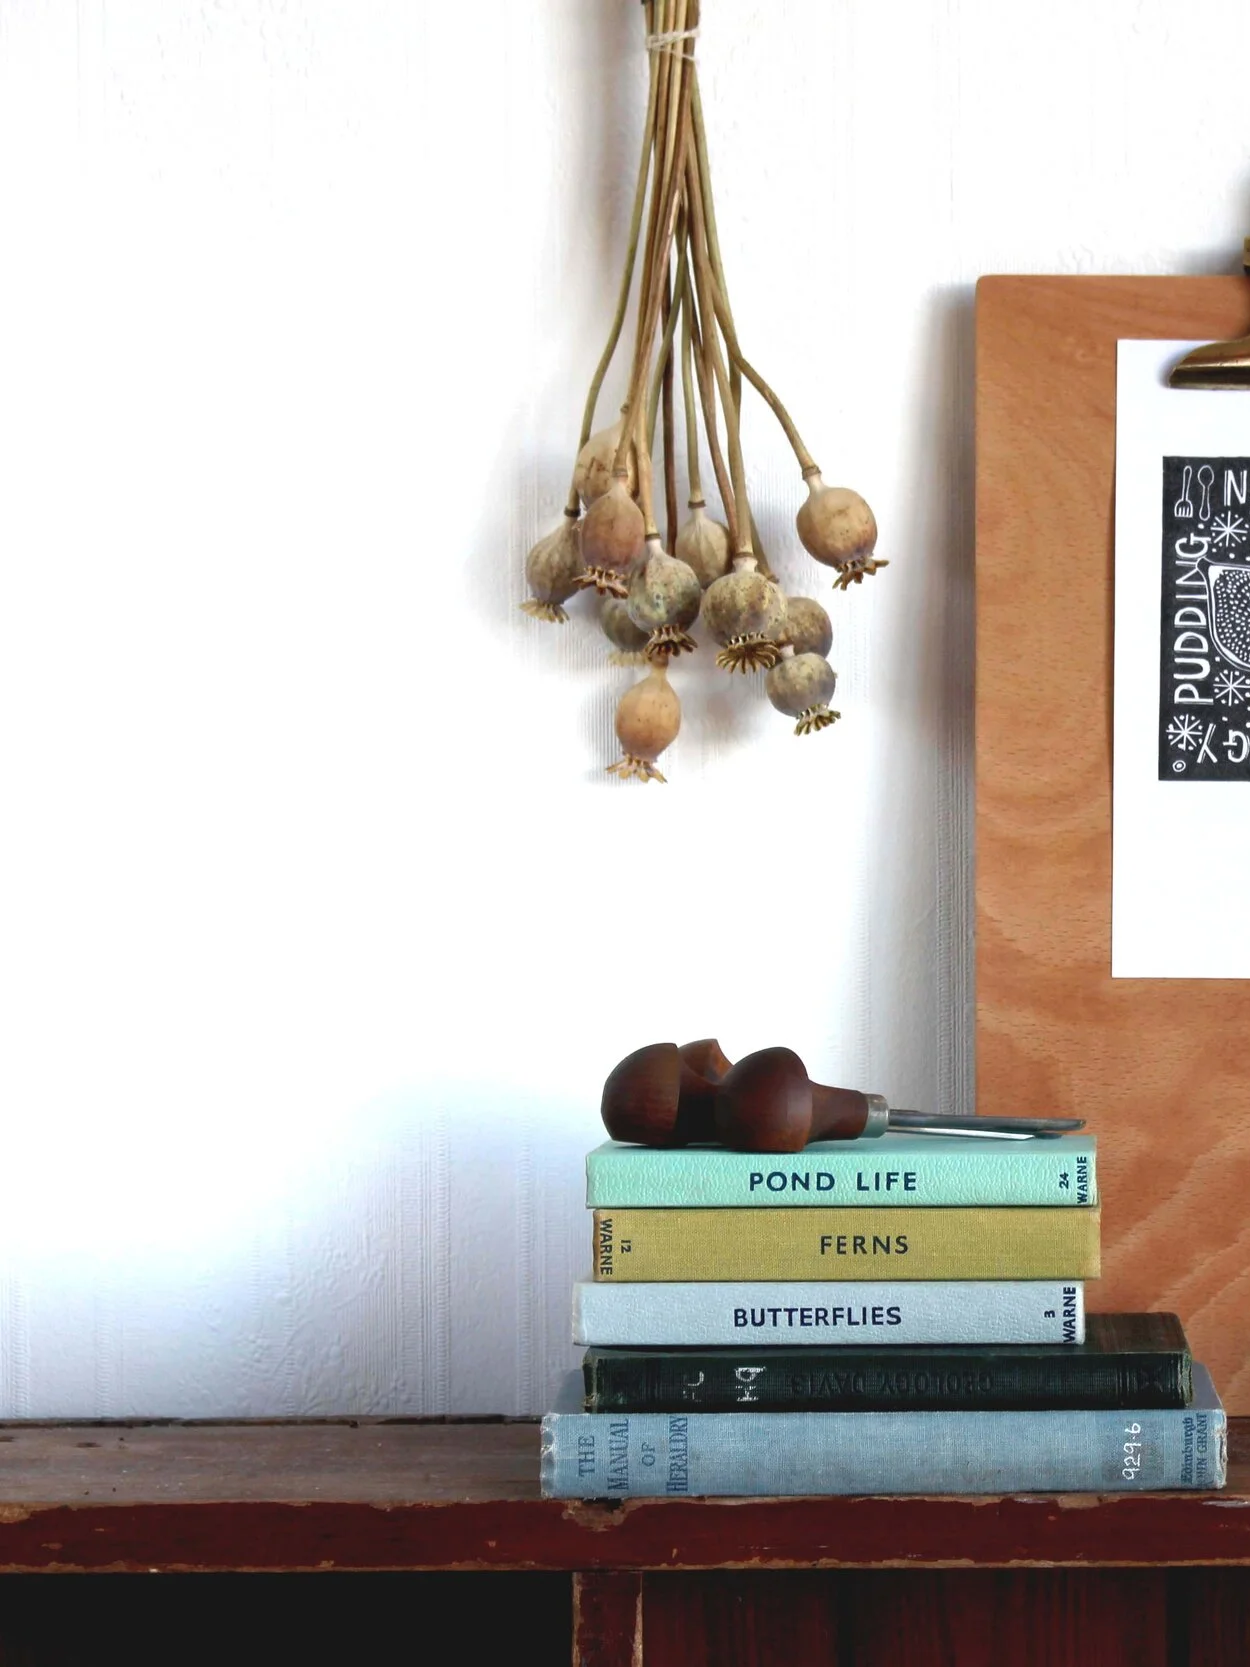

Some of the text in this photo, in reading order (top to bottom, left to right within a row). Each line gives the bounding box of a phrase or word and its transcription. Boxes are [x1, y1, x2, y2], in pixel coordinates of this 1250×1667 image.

[1173, 532, 1214, 704] PUDDING
[750, 1172, 917, 1191] POND LIFE
[1059, 1172, 1070, 1189] 24
[1077, 1156, 1088, 1204] WARNE
[600, 1219, 613, 1276] WARNE
[820, 1235, 909, 1255] FERNS
[734, 1307, 902, 1327] BUTTERFLIES
[1044, 1310, 1056, 1318] 3
[1063, 1287, 1077, 1343] WARNE
[607, 1418, 629, 1490] MANUAL
[641, 1441, 656, 1467] OF
[666, 1415, 688, 1492] HERALDRY
[1196, 1412, 1207, 1454] GRANT
[577, 1435, 595, 1477] THE
